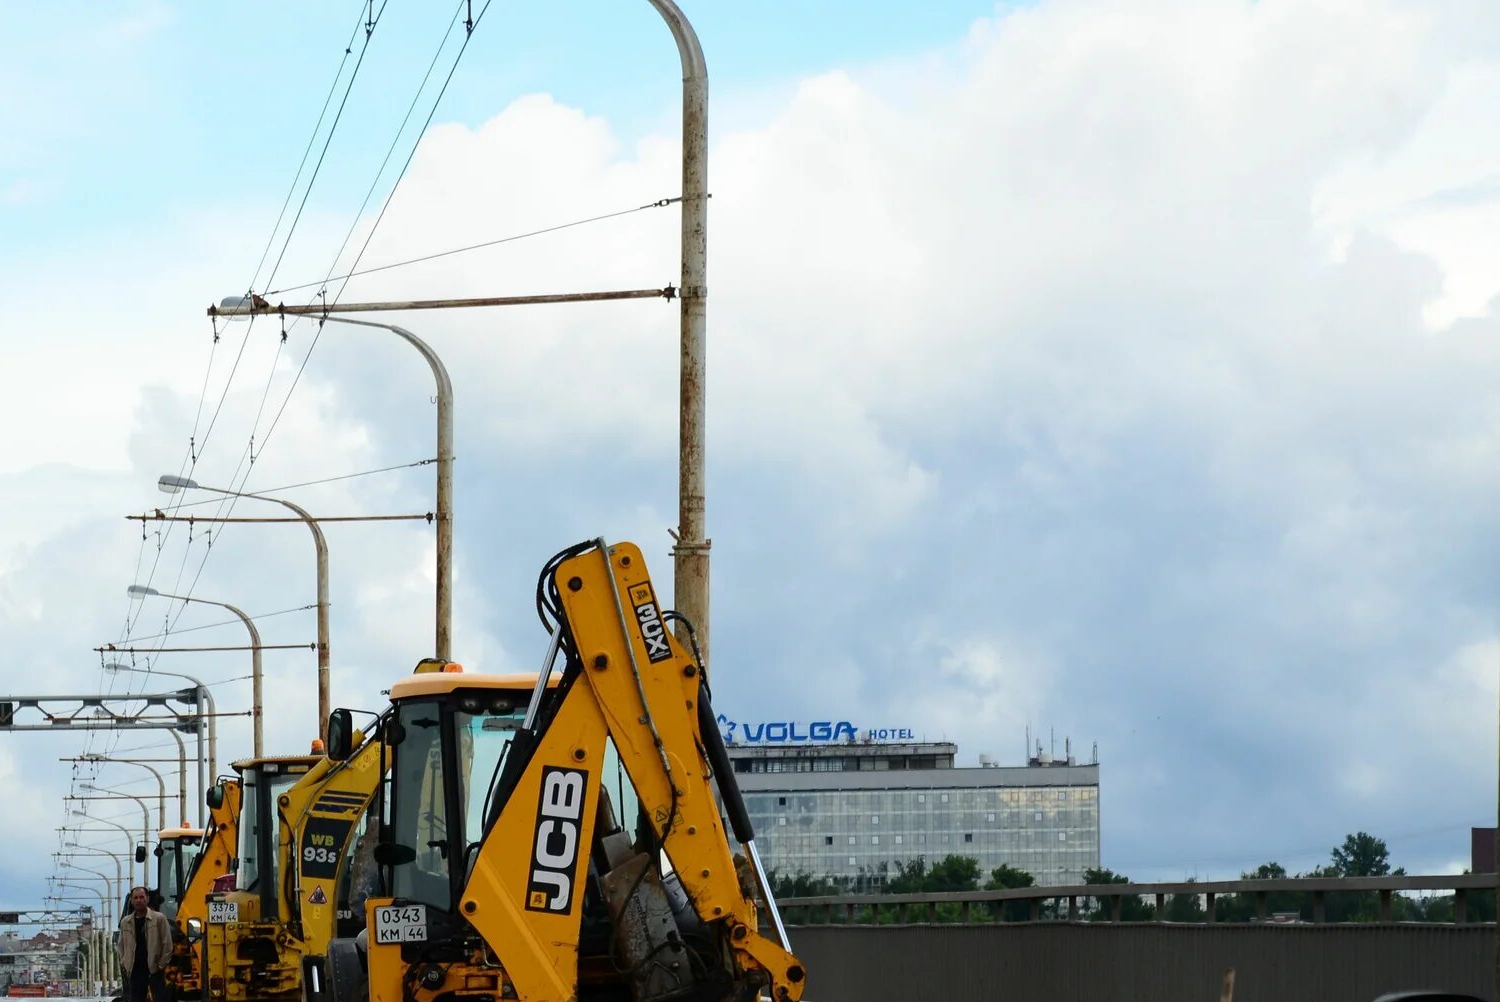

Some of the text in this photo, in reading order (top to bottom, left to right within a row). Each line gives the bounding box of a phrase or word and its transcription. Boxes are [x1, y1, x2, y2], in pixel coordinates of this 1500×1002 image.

[637, 603, 669, 655] 3CX
[742, 721, 914, 742] VOLGA HOTEL
[311, 834, 334, 847] WB
[533, 771, 583, 910] JCB
[212, 903, 235, 912] 3378
[382, 908, 420, 924] 0343
[408, 927, 424, 940] 44
